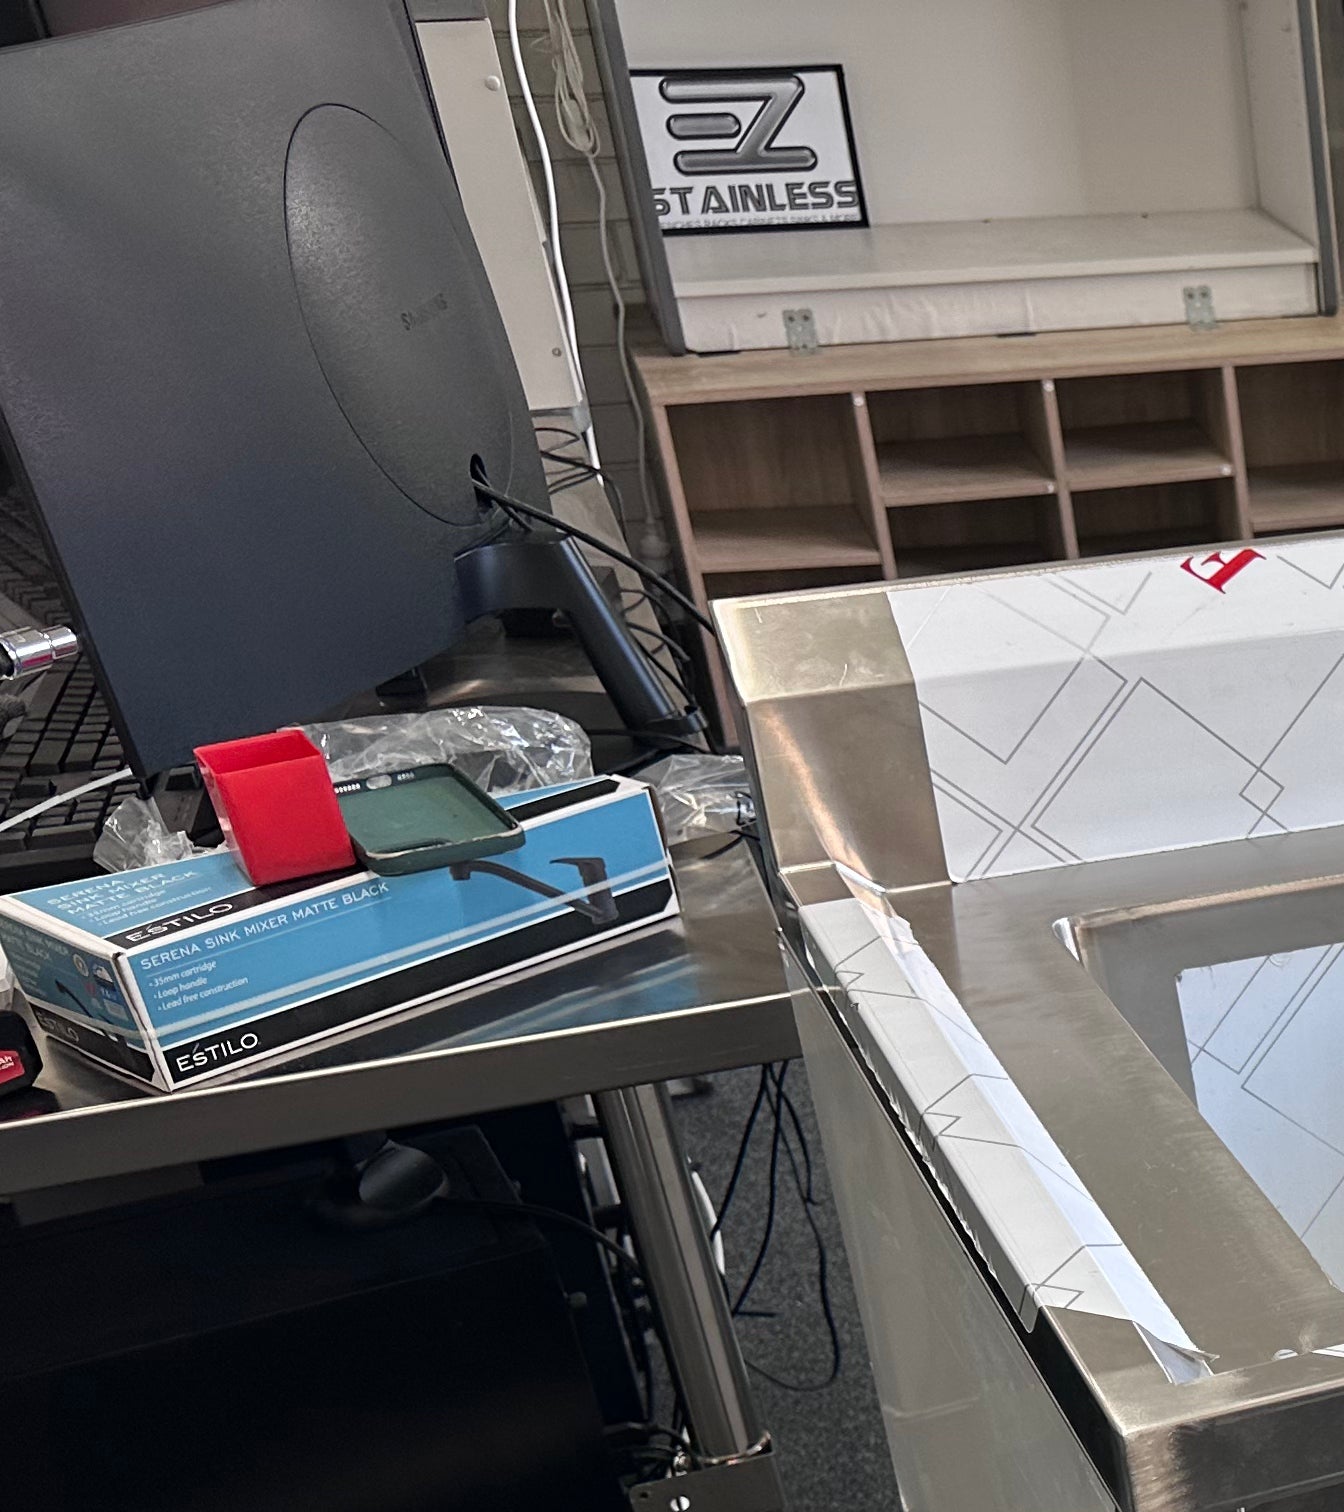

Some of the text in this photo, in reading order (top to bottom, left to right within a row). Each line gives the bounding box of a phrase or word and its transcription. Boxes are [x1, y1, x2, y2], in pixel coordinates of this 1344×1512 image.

[659, 75, 818, 177] EZ
[652, 180, 860, 217] STAINLESS
[140, 881, 389, 970] SERENA SINK MIXER MATTE BLACK
[154, 960, 217, 987] 35mm cartridge
[157, 976, 208, 999] Loop handle
[162, 976, 249, 1011] Lead free construction
